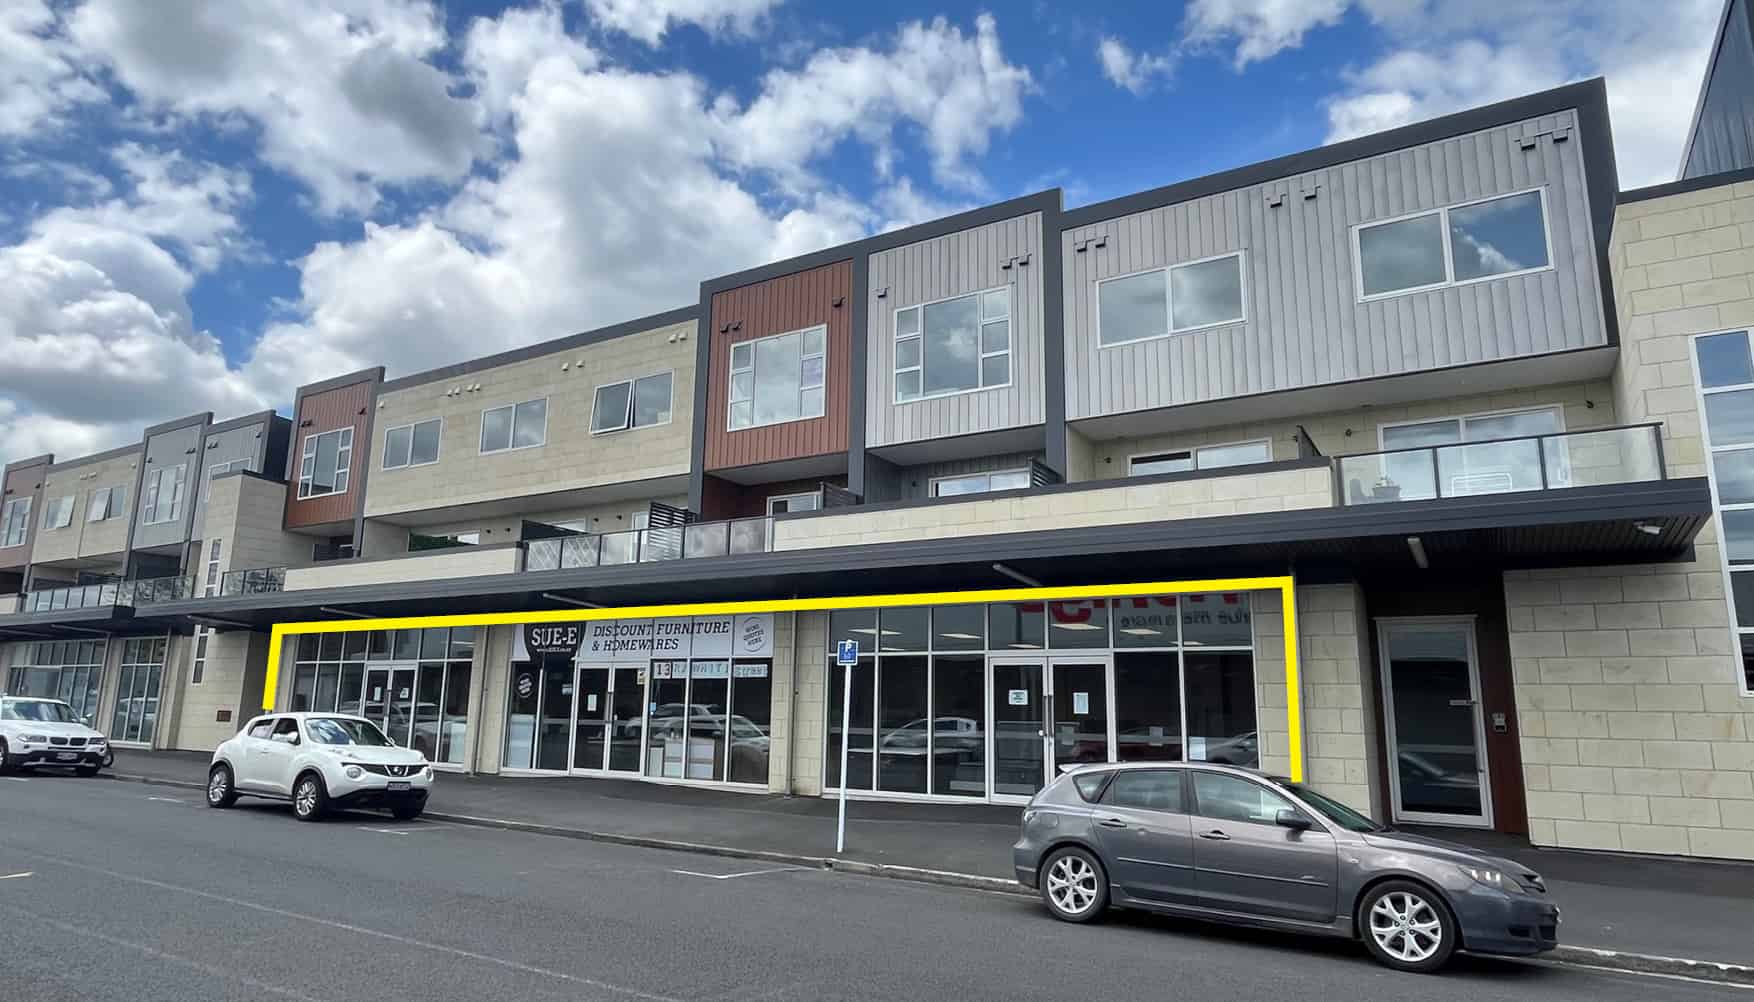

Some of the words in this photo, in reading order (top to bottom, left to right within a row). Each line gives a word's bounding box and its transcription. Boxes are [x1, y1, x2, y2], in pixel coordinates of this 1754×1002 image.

[531, 627, 577, 646] SUE-E
[593, 625, 653, 637] DISCOUNT
[656, 622, 730, 635] FURNITURE
[592, 641, 600, 651] &
[603, 639, 679, 651] HOMEWARES
[656, 663, 671, 676] 13
